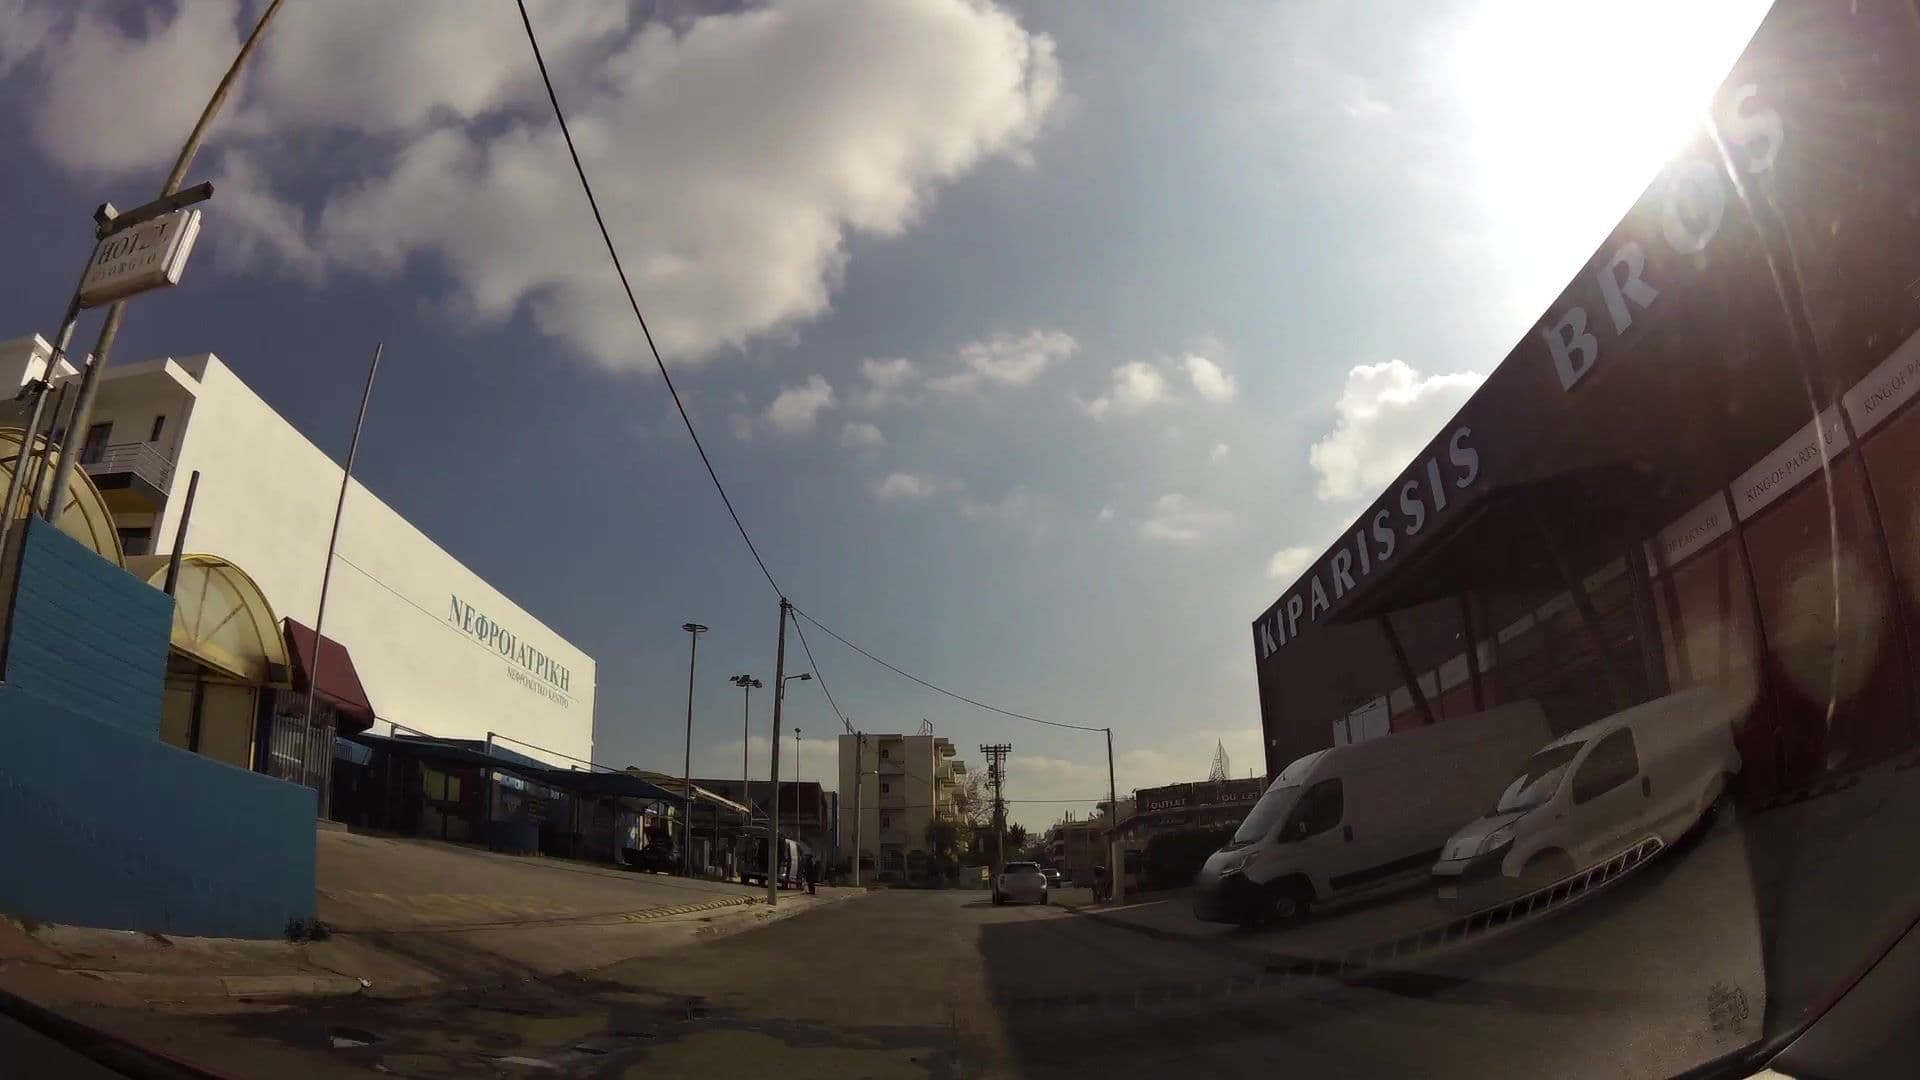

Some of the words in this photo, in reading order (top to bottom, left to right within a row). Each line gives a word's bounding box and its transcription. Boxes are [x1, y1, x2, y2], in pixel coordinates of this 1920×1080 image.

[1260, 425, 1479, 660] KIPARISSIS
[1543, 82, 1785, 392] BROS
[1744, 477, 1773, 502] KING
[1771, 468, 1785, 485] OF
[448, 593, 570, 692] ΝΕΦΡΟΙΑΤΡΙΚΗ
